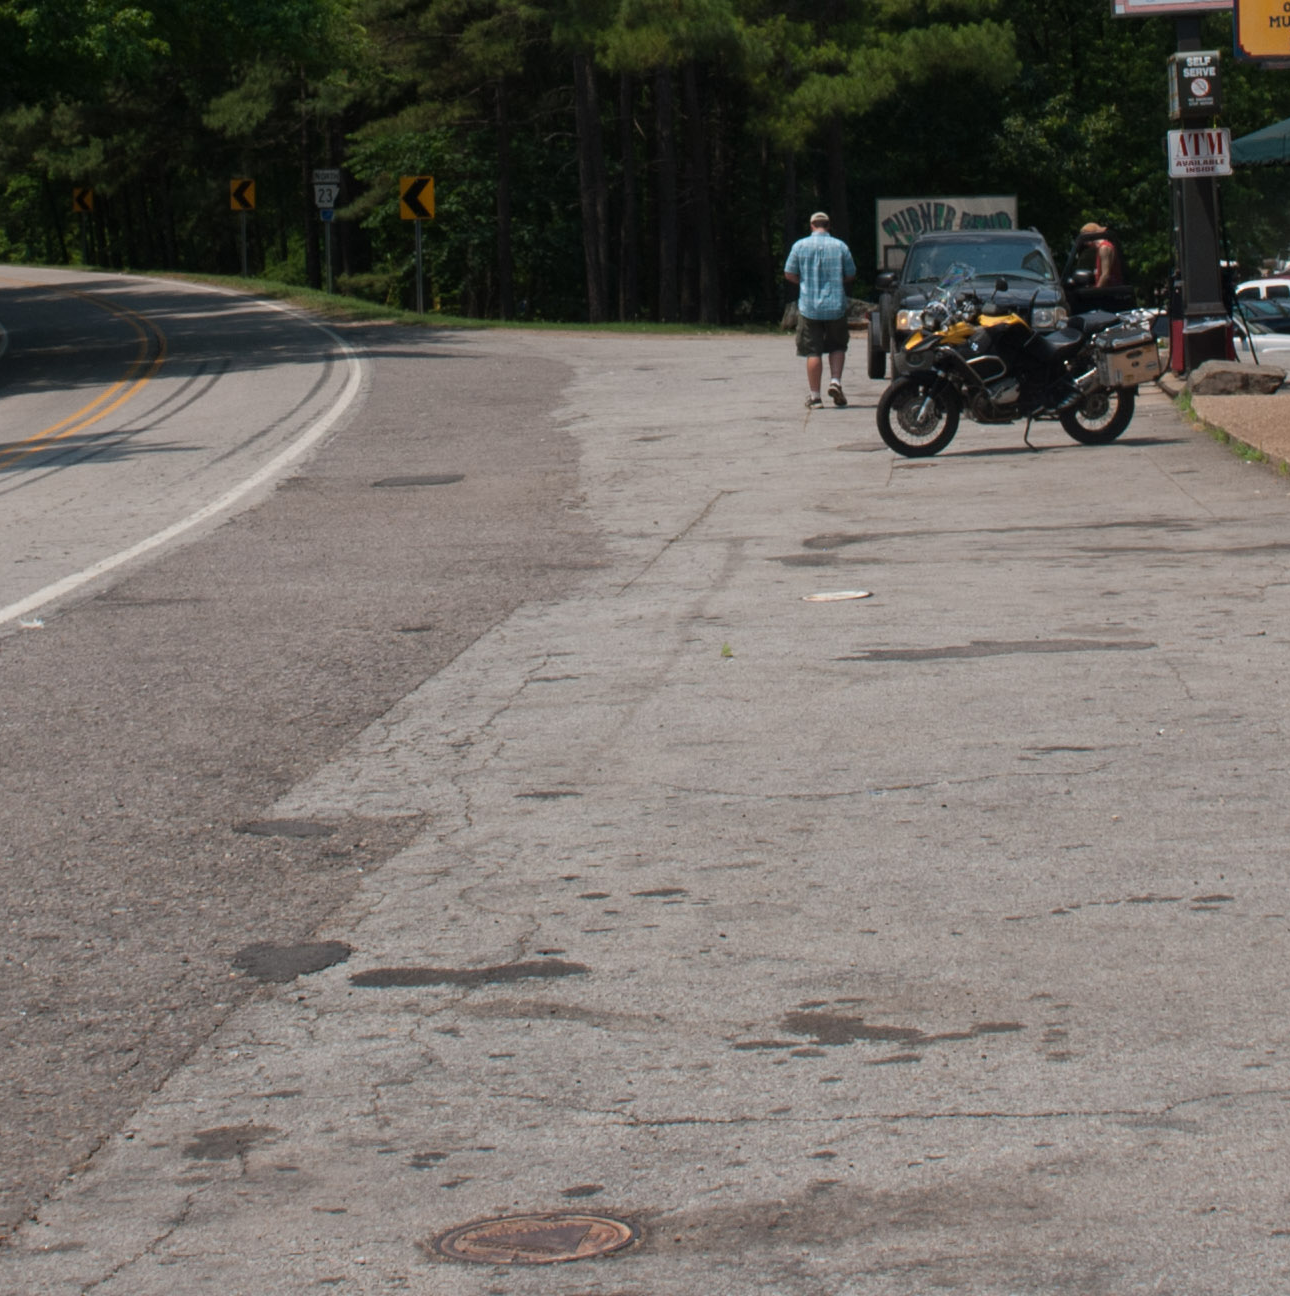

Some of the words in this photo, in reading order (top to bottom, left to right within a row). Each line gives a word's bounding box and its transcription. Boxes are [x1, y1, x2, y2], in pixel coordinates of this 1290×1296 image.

[1186, 56, 1211, 67] SELF
[1183, 67, 1216, 78] SERVE
[1176, 132, 1223, 157] ATM
[1176, 159, 1224, 167] AVAILABLE
[318, 188, 333, 203] 23
[881, 202, 956, 245] TURNER
